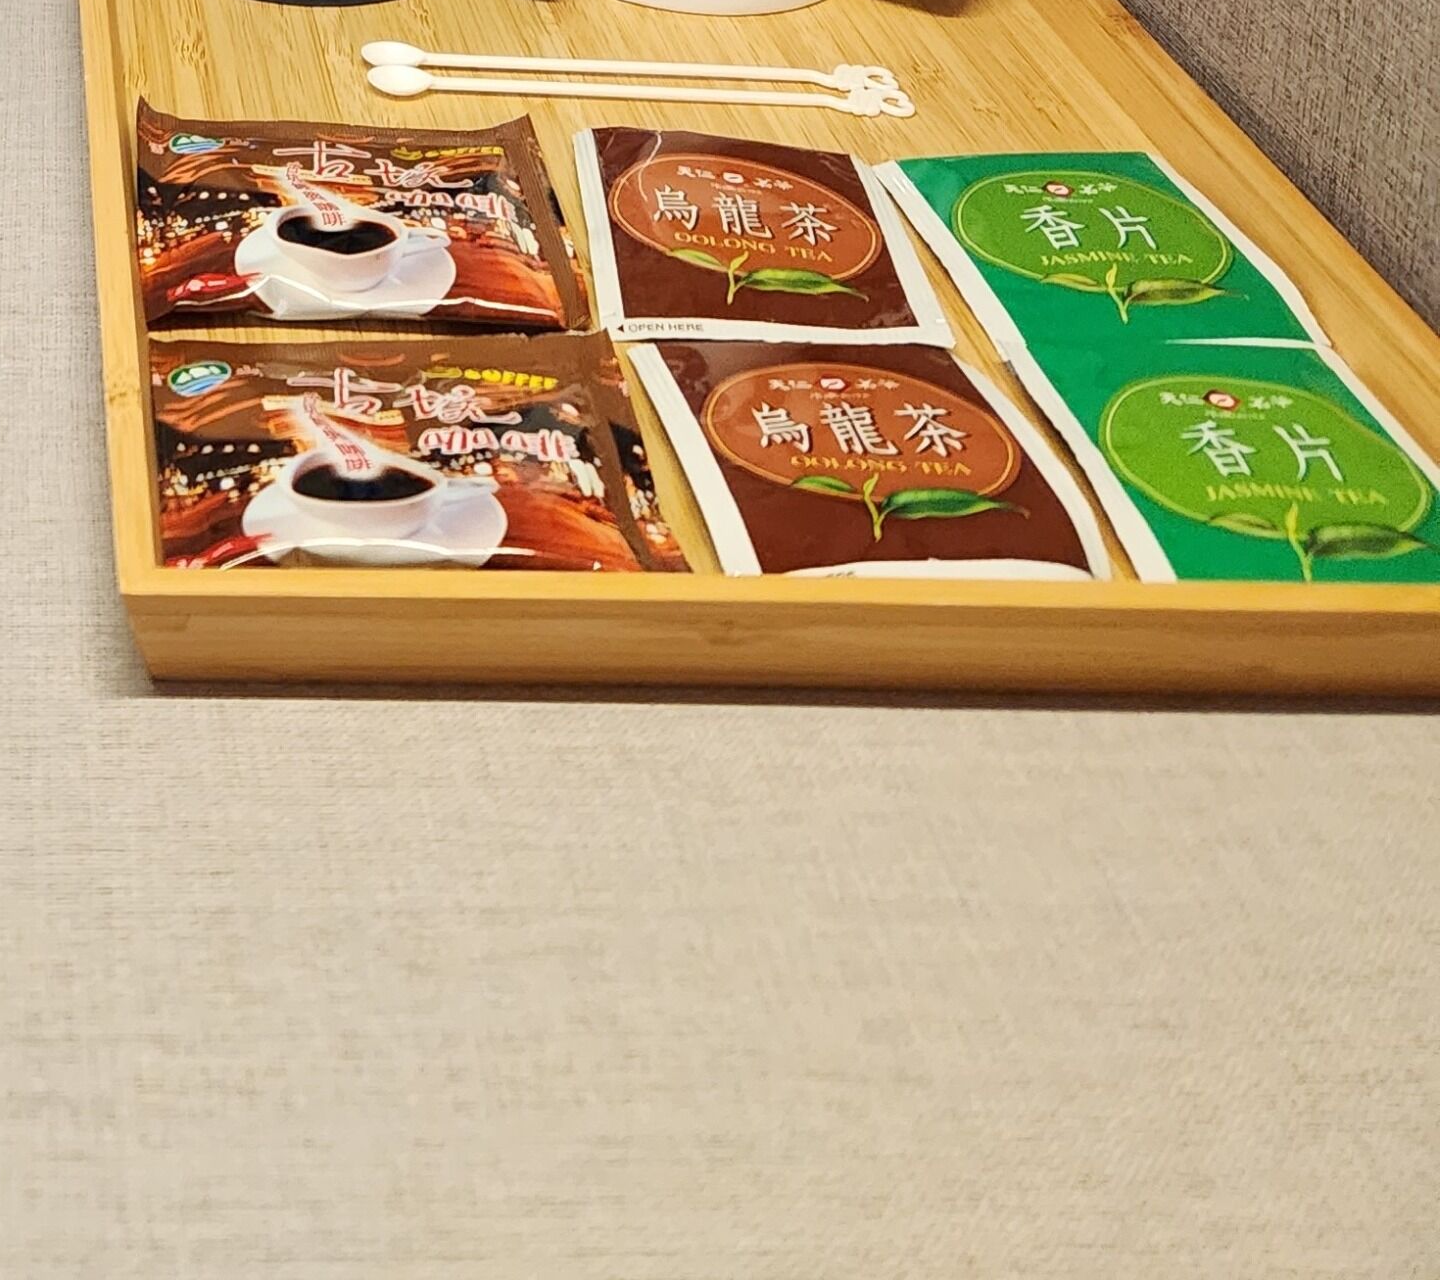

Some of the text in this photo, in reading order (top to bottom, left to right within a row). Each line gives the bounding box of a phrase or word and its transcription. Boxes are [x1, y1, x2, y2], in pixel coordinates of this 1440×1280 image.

[653, 184, 839, 246] 烏龍茶
[1018, 203, 1159, 251] 香片
[673, 231, 833, 263] OOLONG TEA
[1039, 250, 1194, 267] JASMINE TEA
[628, 322, 704, 333] OPEN HERE
[752, 400, 969, 458] 烏龍茶
[790, 453, 973, 477] OOLONG TEA
[1180, 418, 1345, 483] 香片
